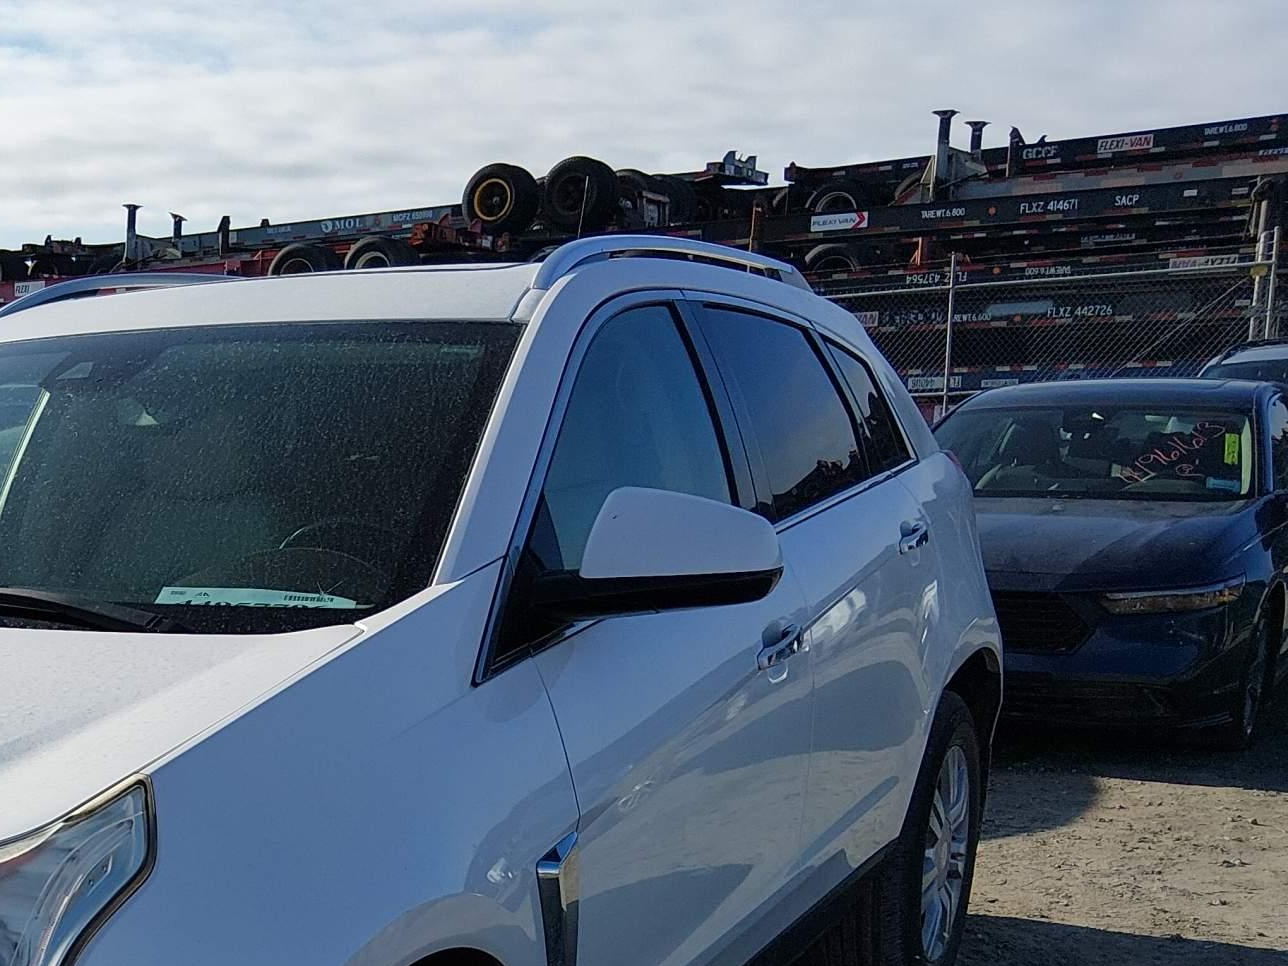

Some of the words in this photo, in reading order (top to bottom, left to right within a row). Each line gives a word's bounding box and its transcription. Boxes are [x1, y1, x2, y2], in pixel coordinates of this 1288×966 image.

[1099, 135, 1153, 151] FLEXI-VAN
[1020, 200, 1044, 214] FLXZ
[1047, 199, 1078, 211] 414671
[1114, 194, 1140, 206] SACP
[334, 218, 362, 231] MOL
[944, 271, 968, 283] FLZ
[1047, 306, 1072, 318] FLXZ
[1074, 304, 1113, 316] 442726
